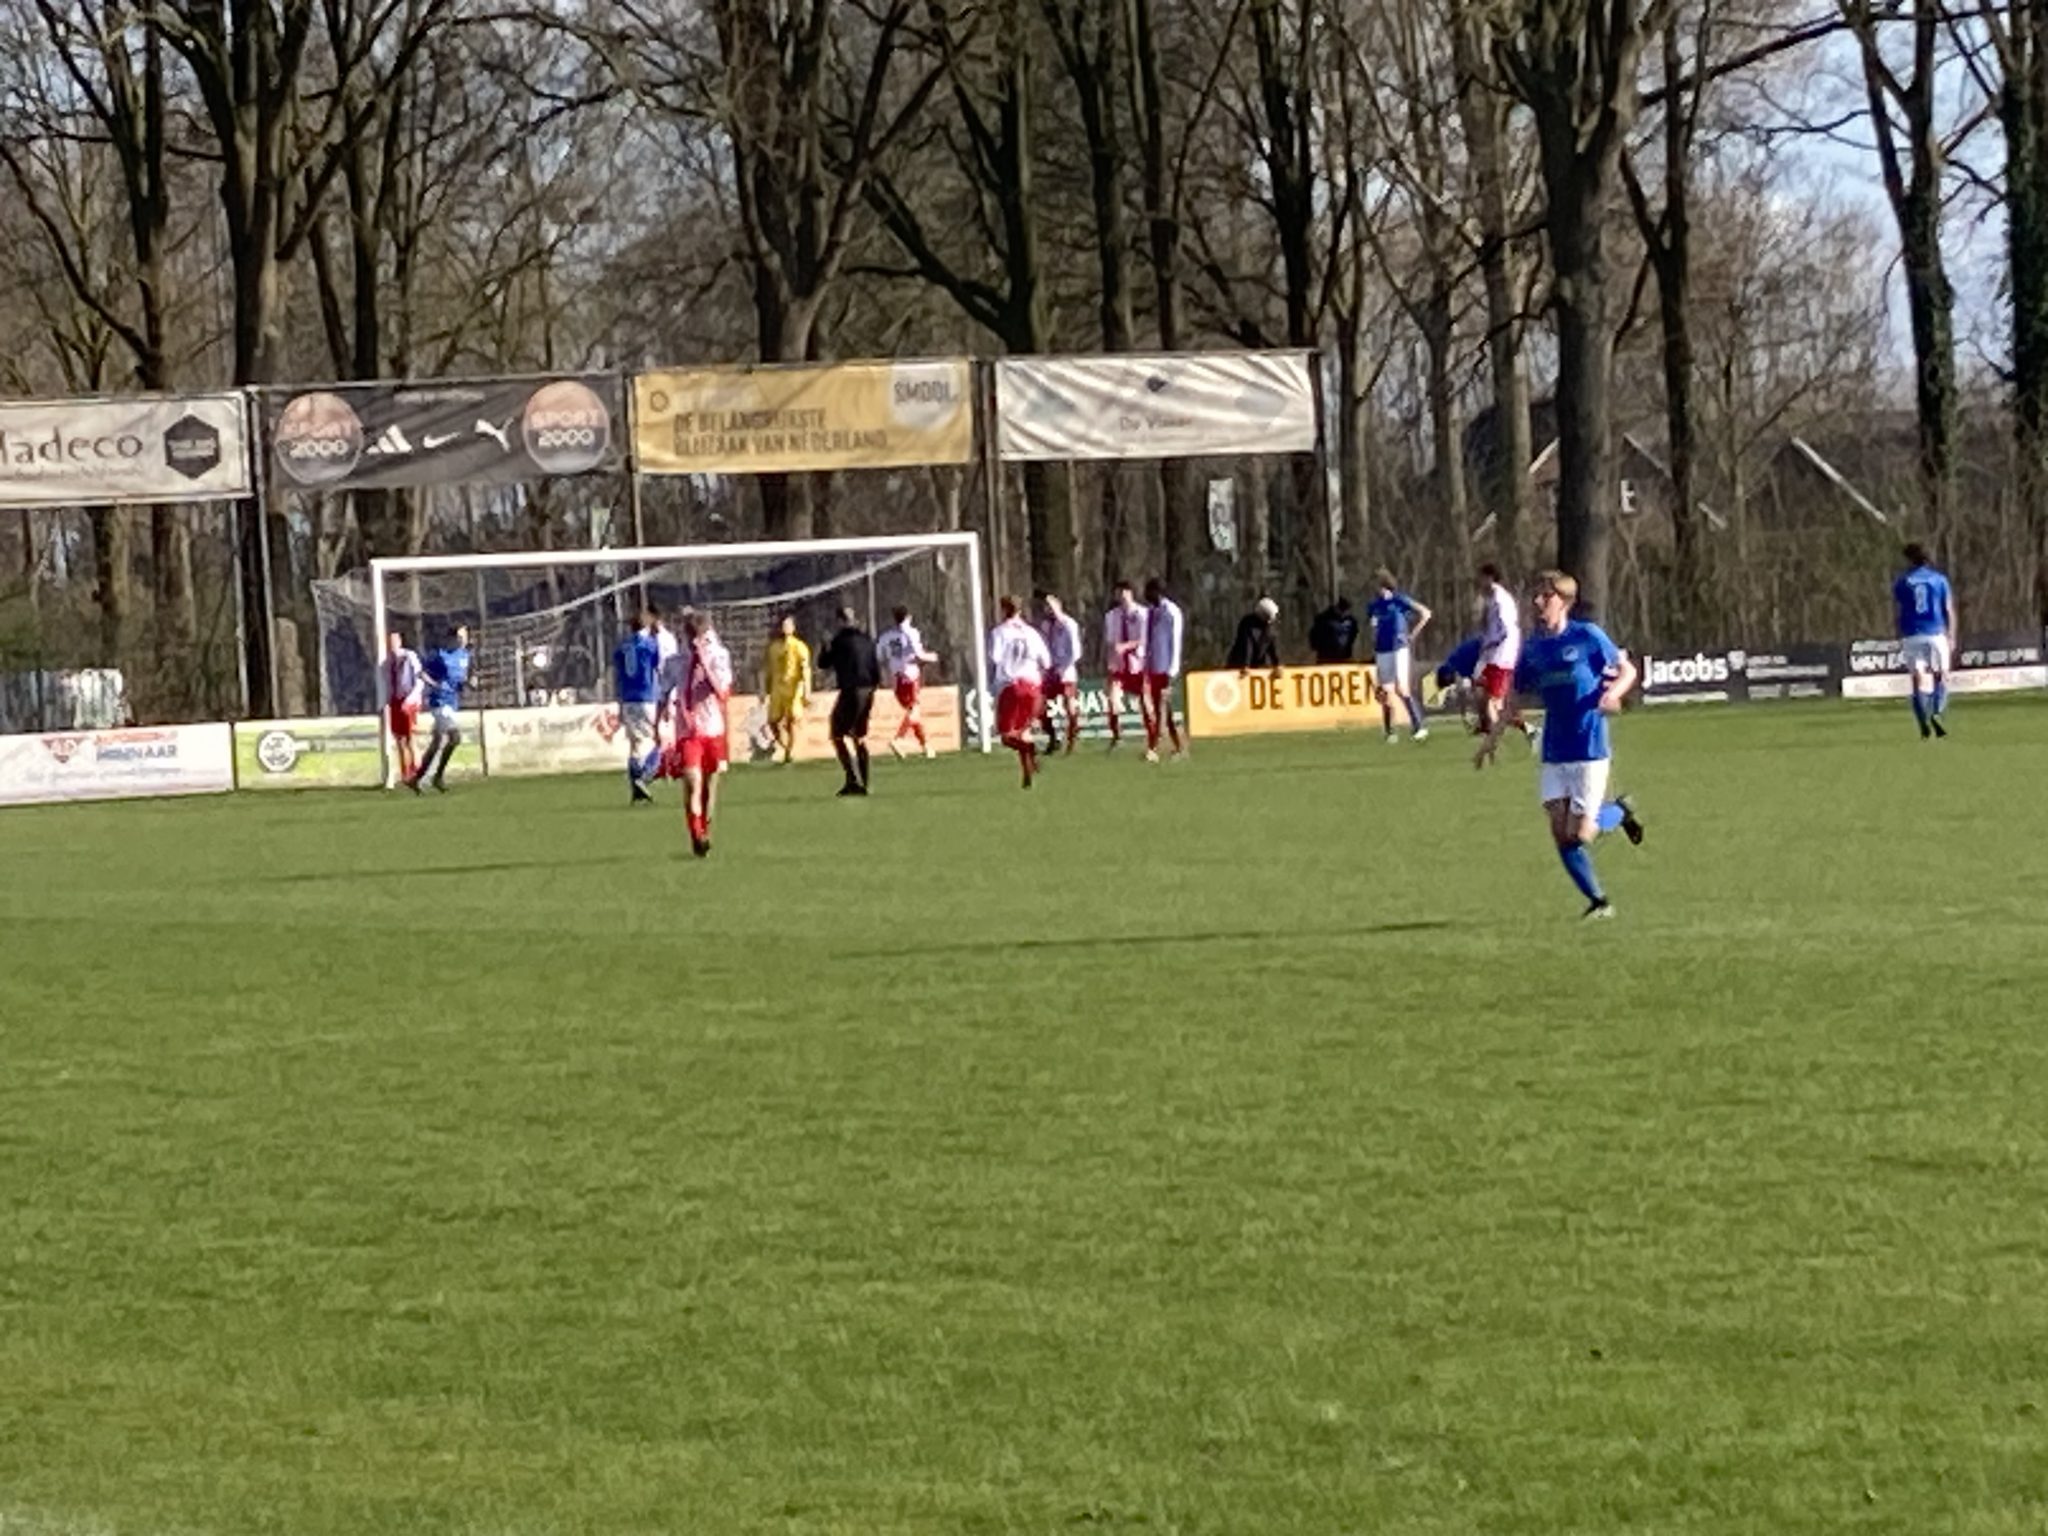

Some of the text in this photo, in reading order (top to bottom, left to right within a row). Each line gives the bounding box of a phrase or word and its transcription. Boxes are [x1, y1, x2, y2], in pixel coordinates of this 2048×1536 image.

[290, 439, 349, 458] 2000
[538, 428, 597, 448] 2000
[1642, 653, 1729, 689] Jacobs
[1250, 673, 1284, 710] DE
